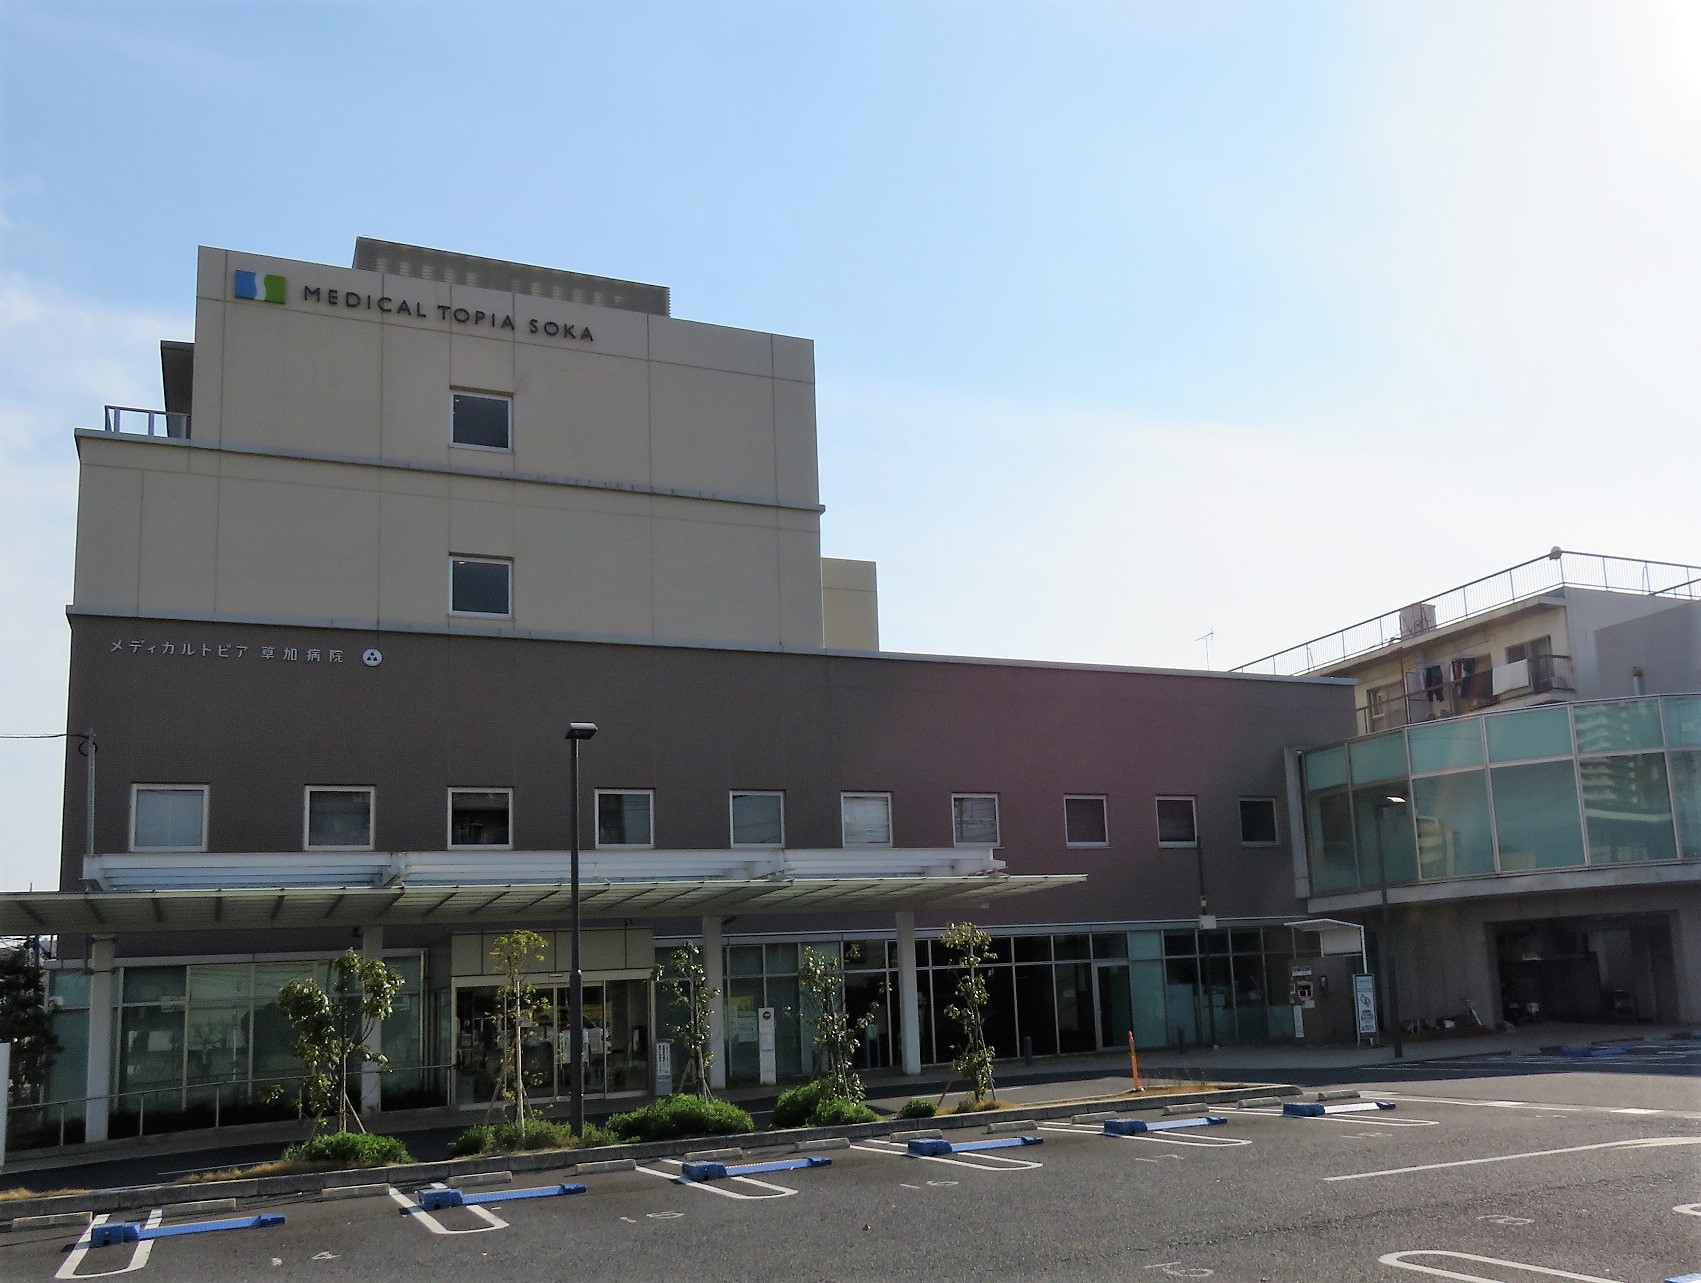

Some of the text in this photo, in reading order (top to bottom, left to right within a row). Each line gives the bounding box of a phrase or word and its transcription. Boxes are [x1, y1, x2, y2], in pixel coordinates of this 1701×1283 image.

[303, 285, 594, 342] MEDICAL TOPIA SOKA
[261, 646, 344, 664] 草加病院
